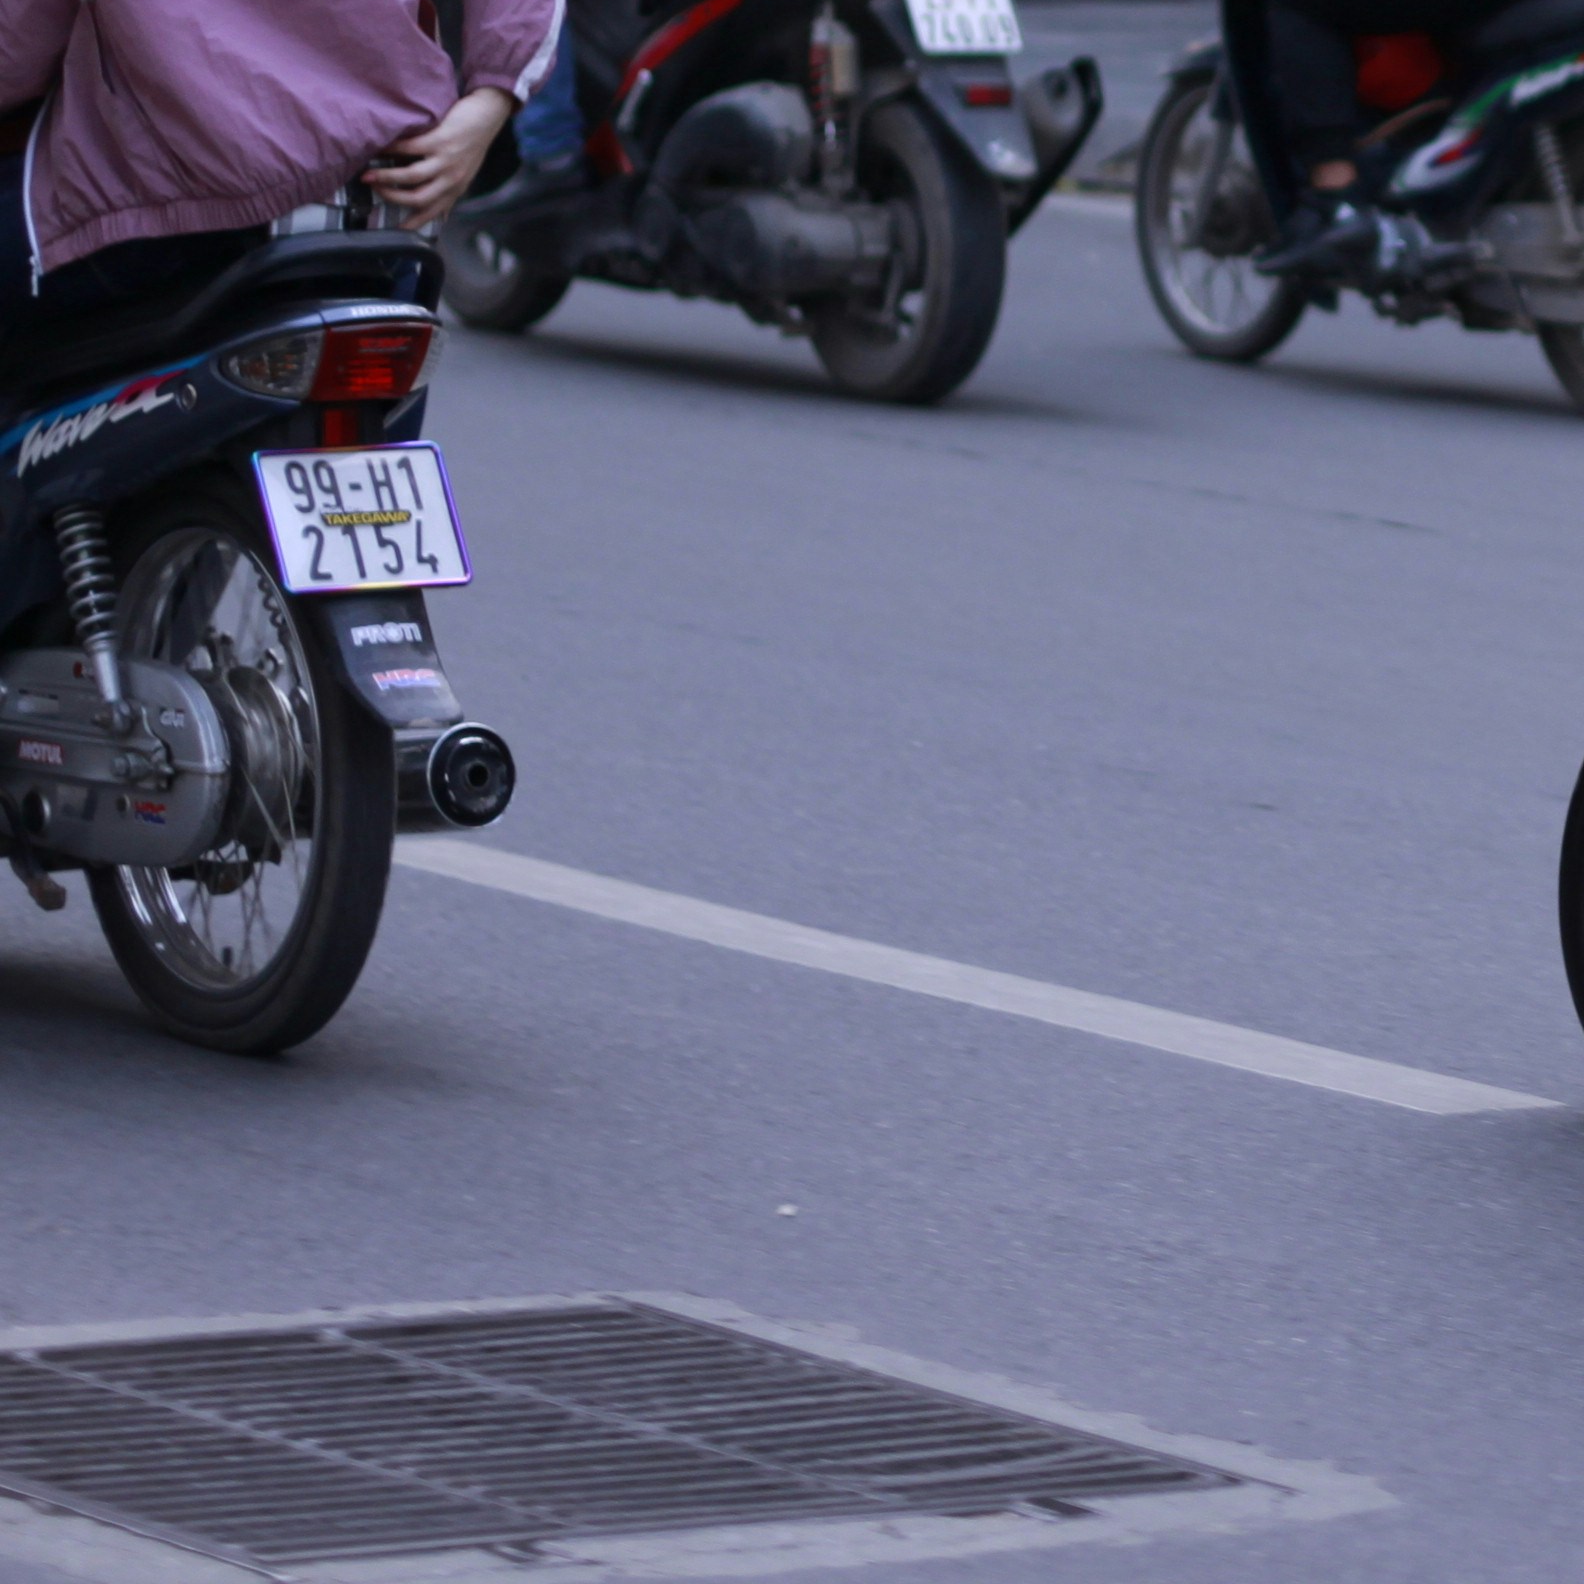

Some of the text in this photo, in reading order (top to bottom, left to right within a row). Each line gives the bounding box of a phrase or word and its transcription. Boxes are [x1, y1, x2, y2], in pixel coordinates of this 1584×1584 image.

[284, 456, 424, 514] 99-H1
[323, 511, 410, 525] TAKEGAWA
[302, 519, 439, 582] 2154
[18, 741, 64, 766] MOTUL
